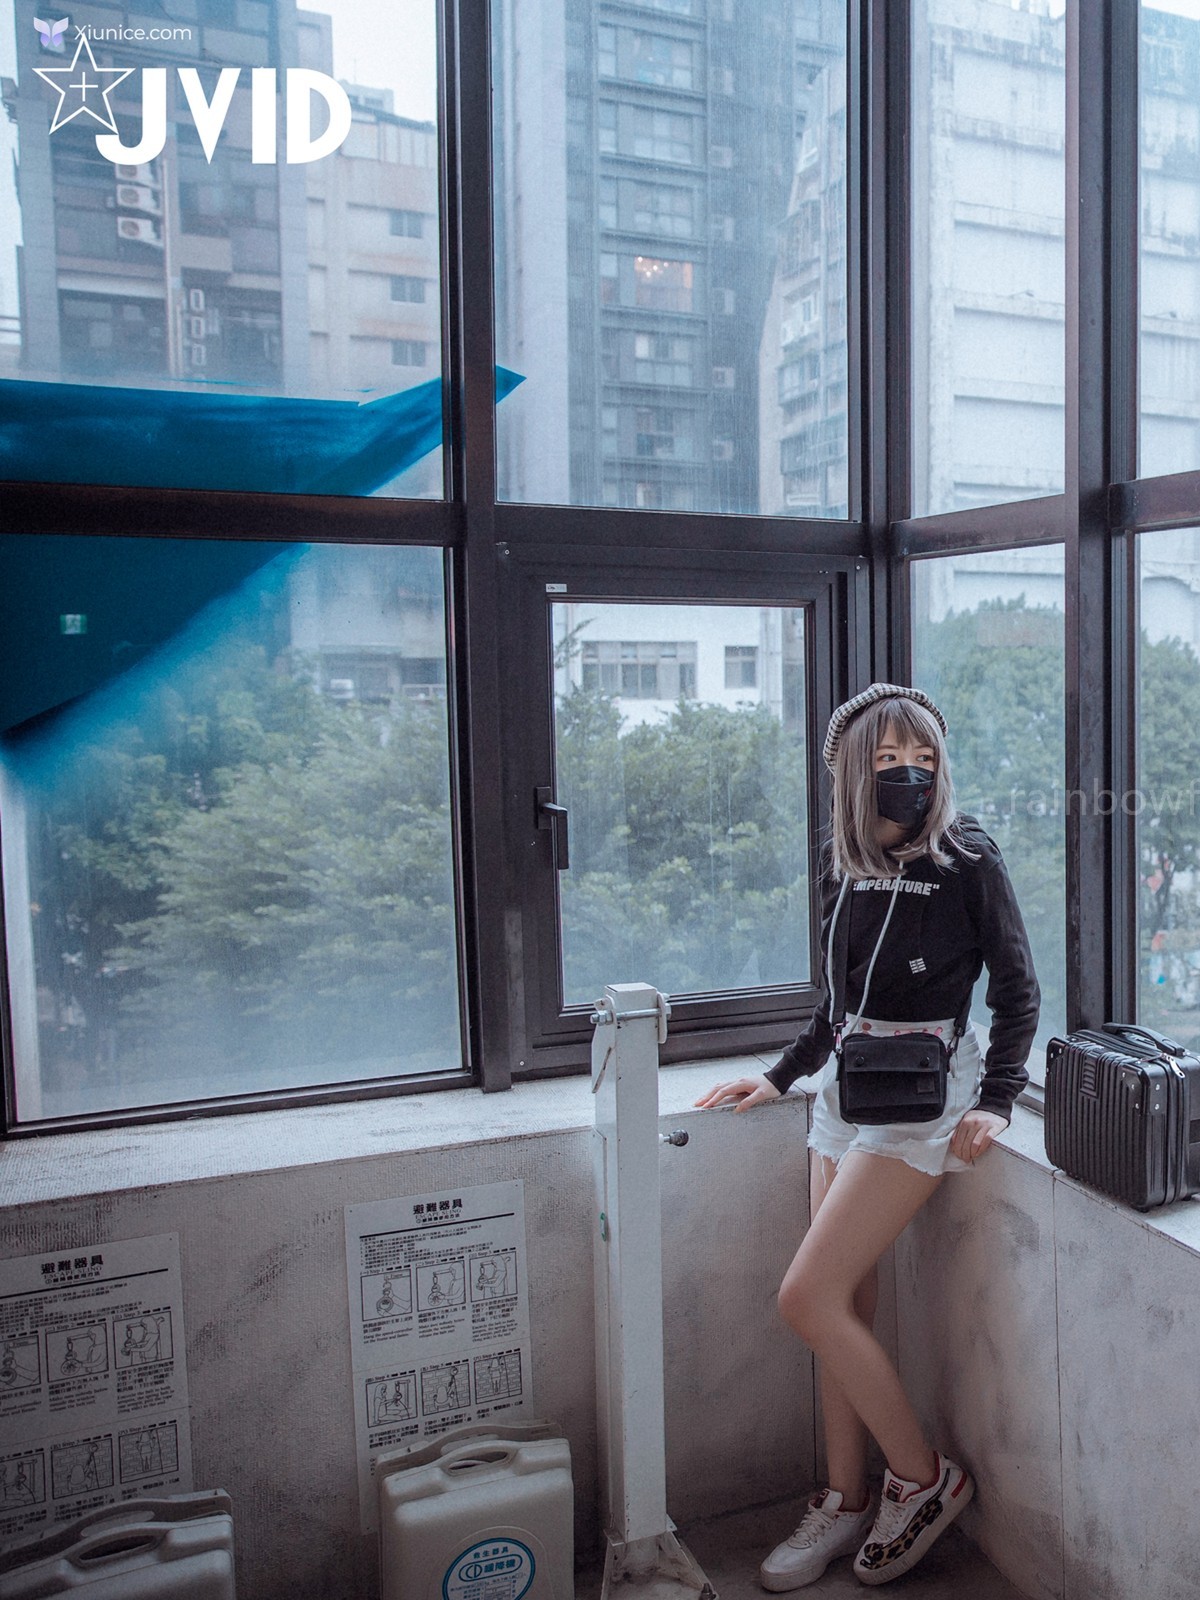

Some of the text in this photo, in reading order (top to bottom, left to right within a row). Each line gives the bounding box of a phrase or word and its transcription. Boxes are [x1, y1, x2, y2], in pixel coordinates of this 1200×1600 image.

[413, 1198, 463, 1215] 避難器具
[41, 1254, 103, 1275] 避難器具
[77, 1265, 102, 1274] SLING
